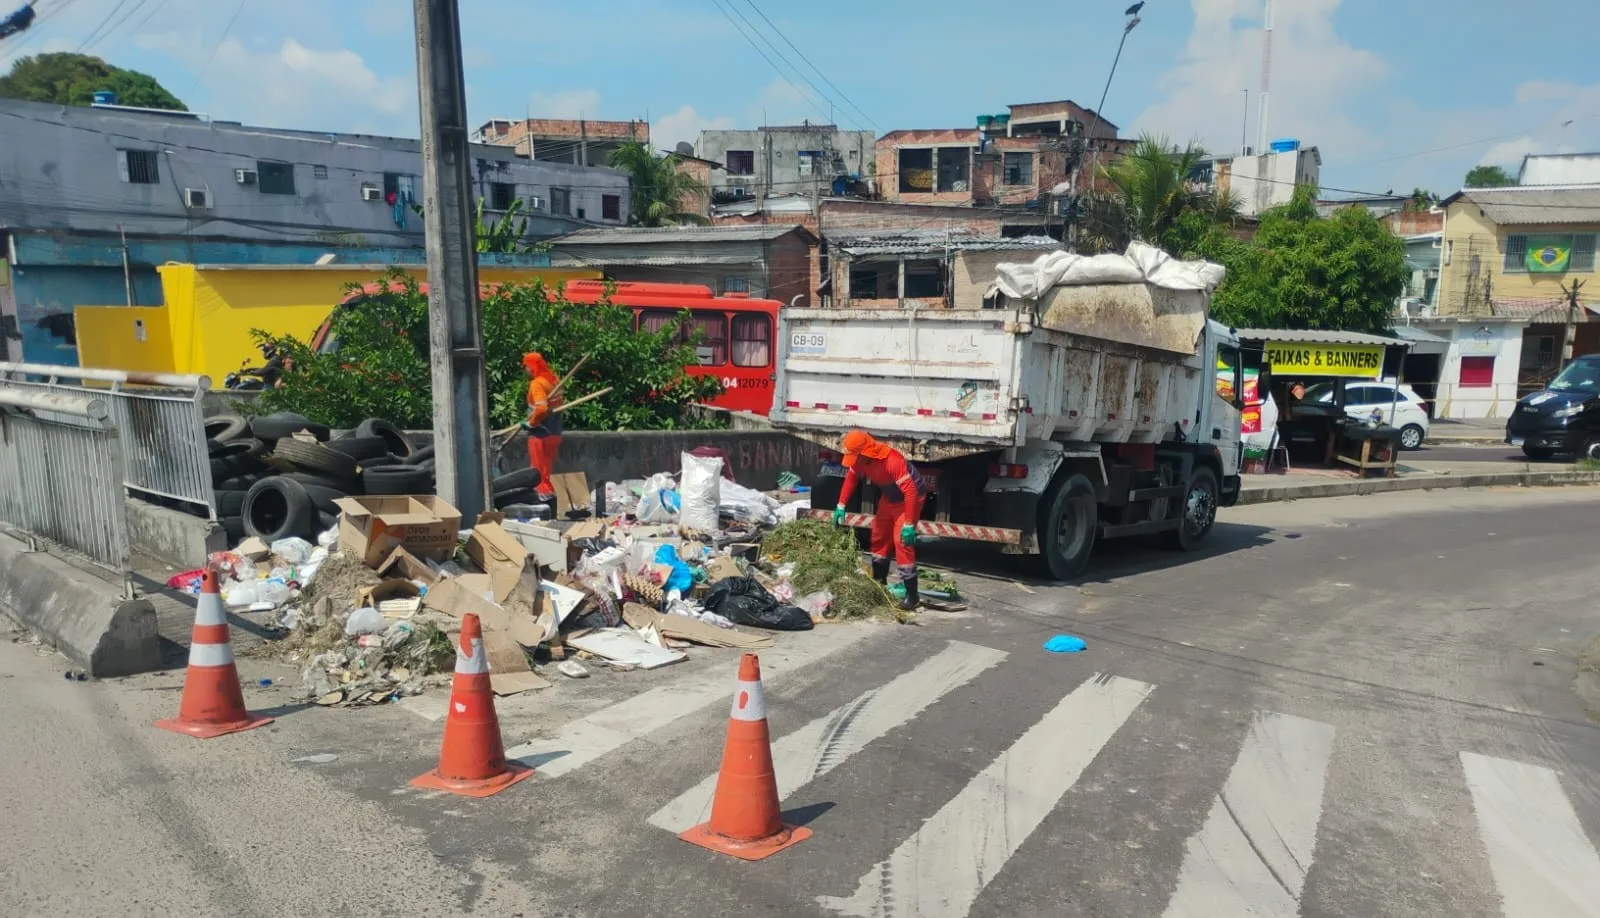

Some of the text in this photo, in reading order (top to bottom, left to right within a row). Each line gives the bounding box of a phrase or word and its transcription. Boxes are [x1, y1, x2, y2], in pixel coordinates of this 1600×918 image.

[793, 335, 824, 346] CB-09
[1268, 350, 1379, 368] FAIXAS & BANNERS
